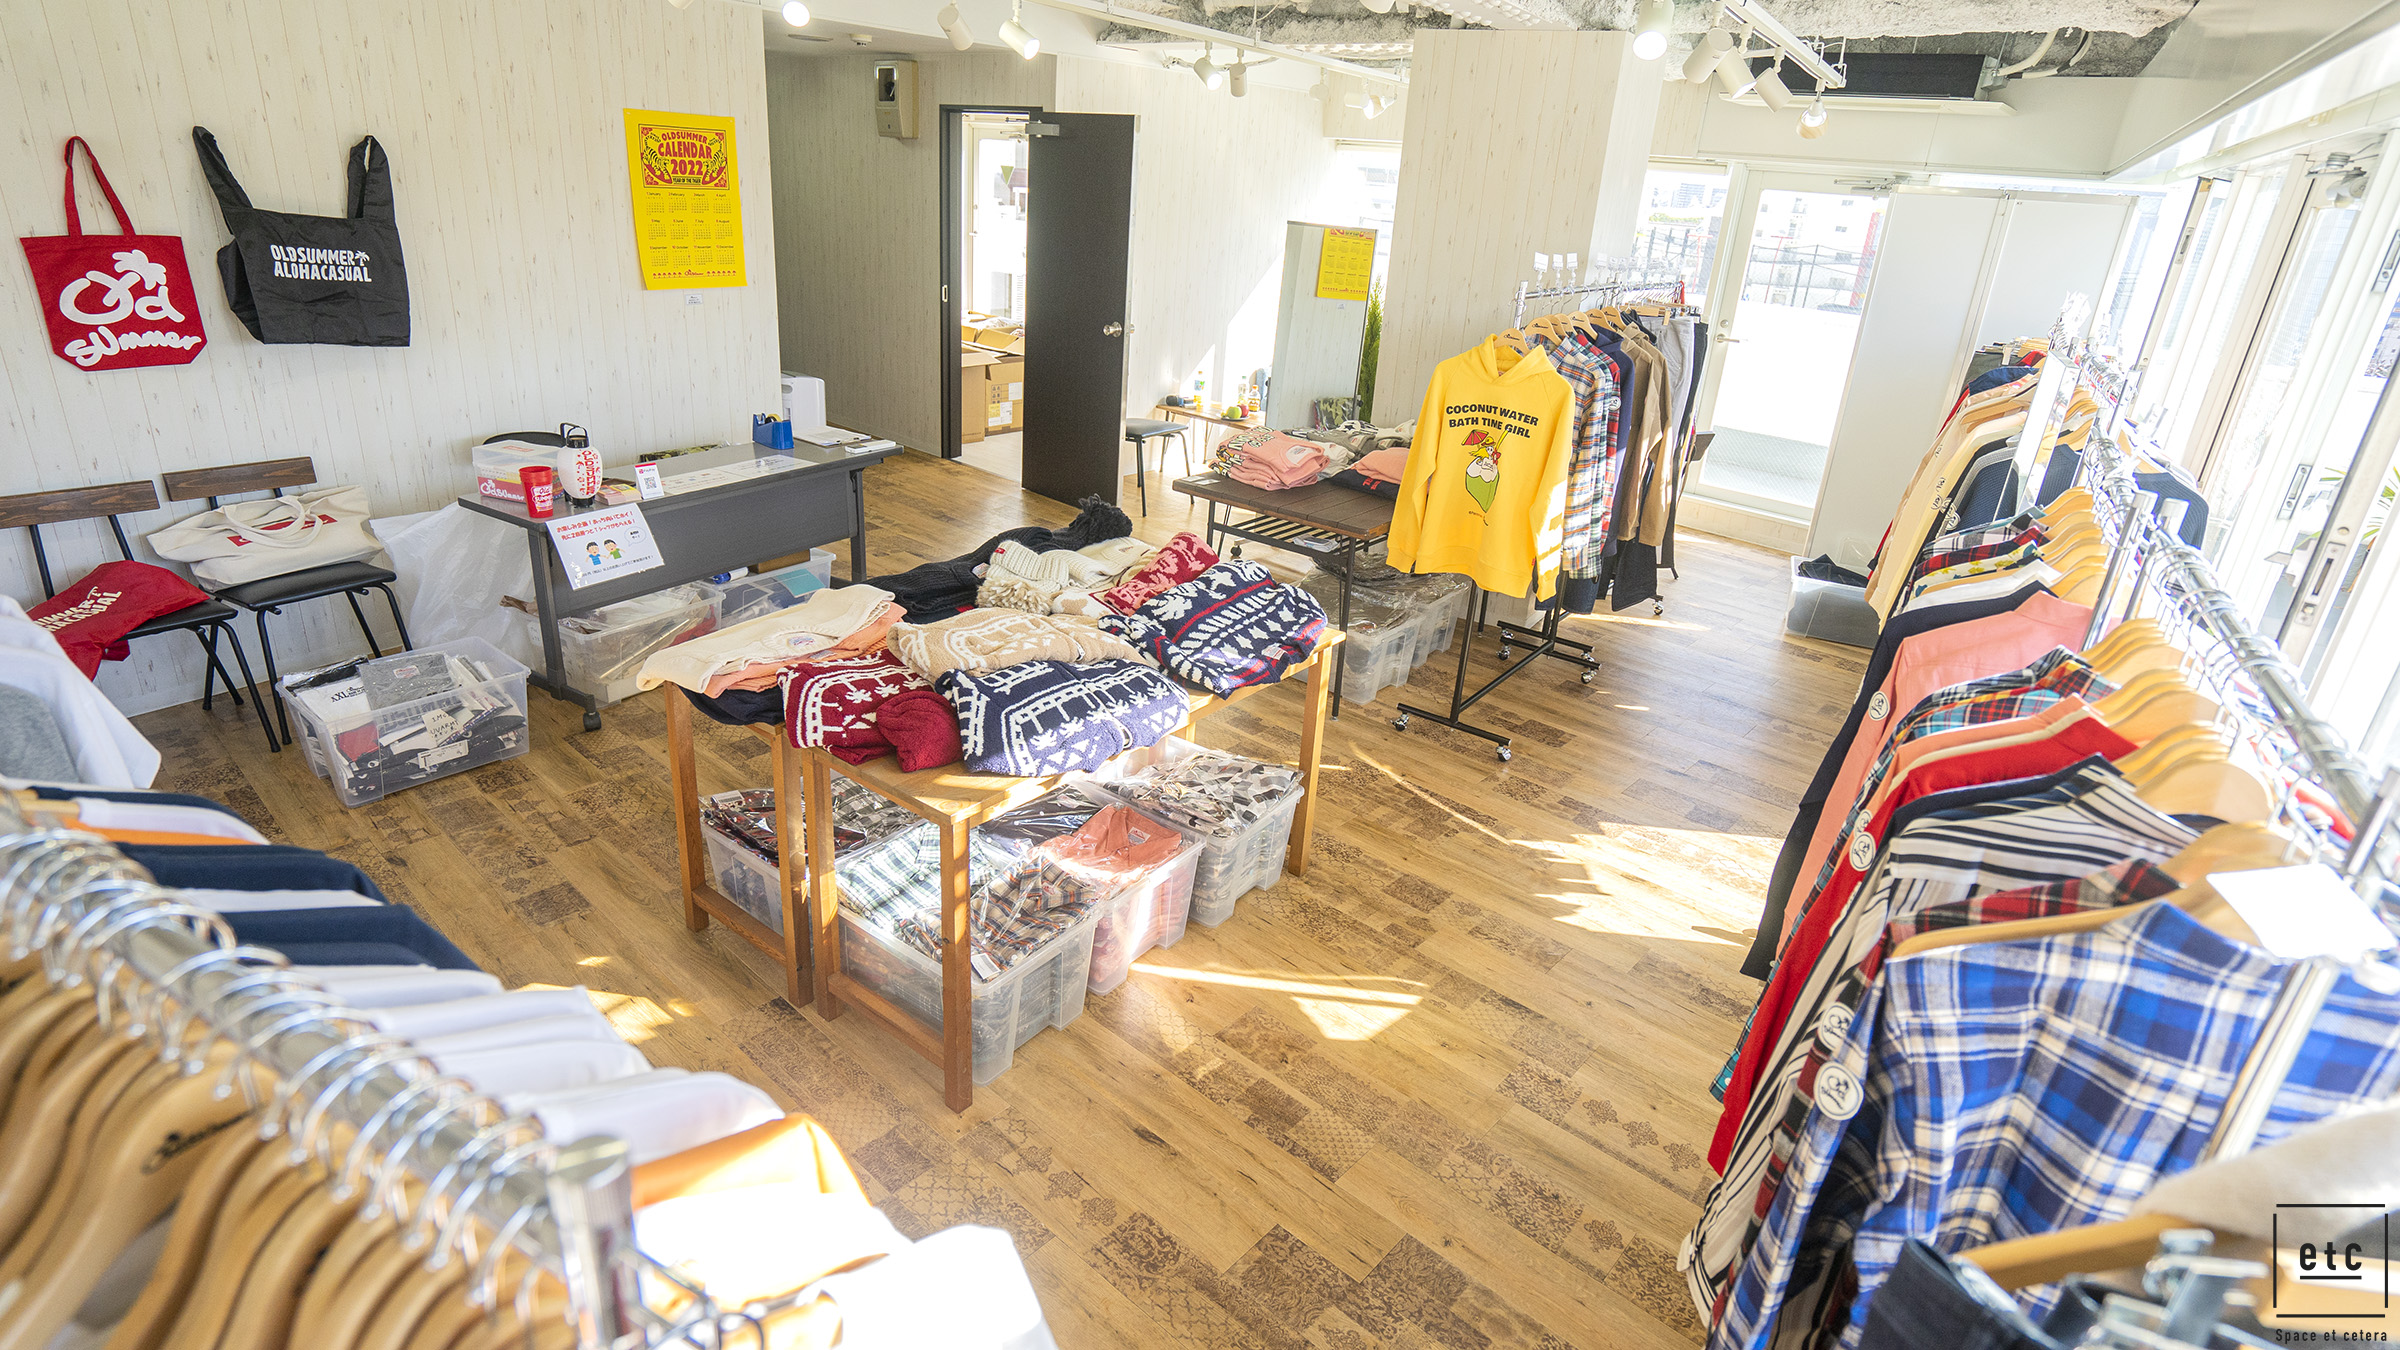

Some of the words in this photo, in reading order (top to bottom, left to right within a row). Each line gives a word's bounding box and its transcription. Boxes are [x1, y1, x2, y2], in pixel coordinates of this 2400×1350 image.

[661, 132, 708, 144] OLDSUMMER
[657, 141, 713, 159] CALENDAR
[670, 159, 704, 175] 2022
[270, 244, 356, 266] OLDSUMMER
[274, 261, 373, 283] ALOHACASUAL
[1446, 404, 1498, 415] COCONUT
[1499, 407, 1539, 426] WATER
[1449, 417, 1478, 428] BATH
[1505, 424, 1531, 438] GIRL
[33, 599, 96, 626] UMMER
